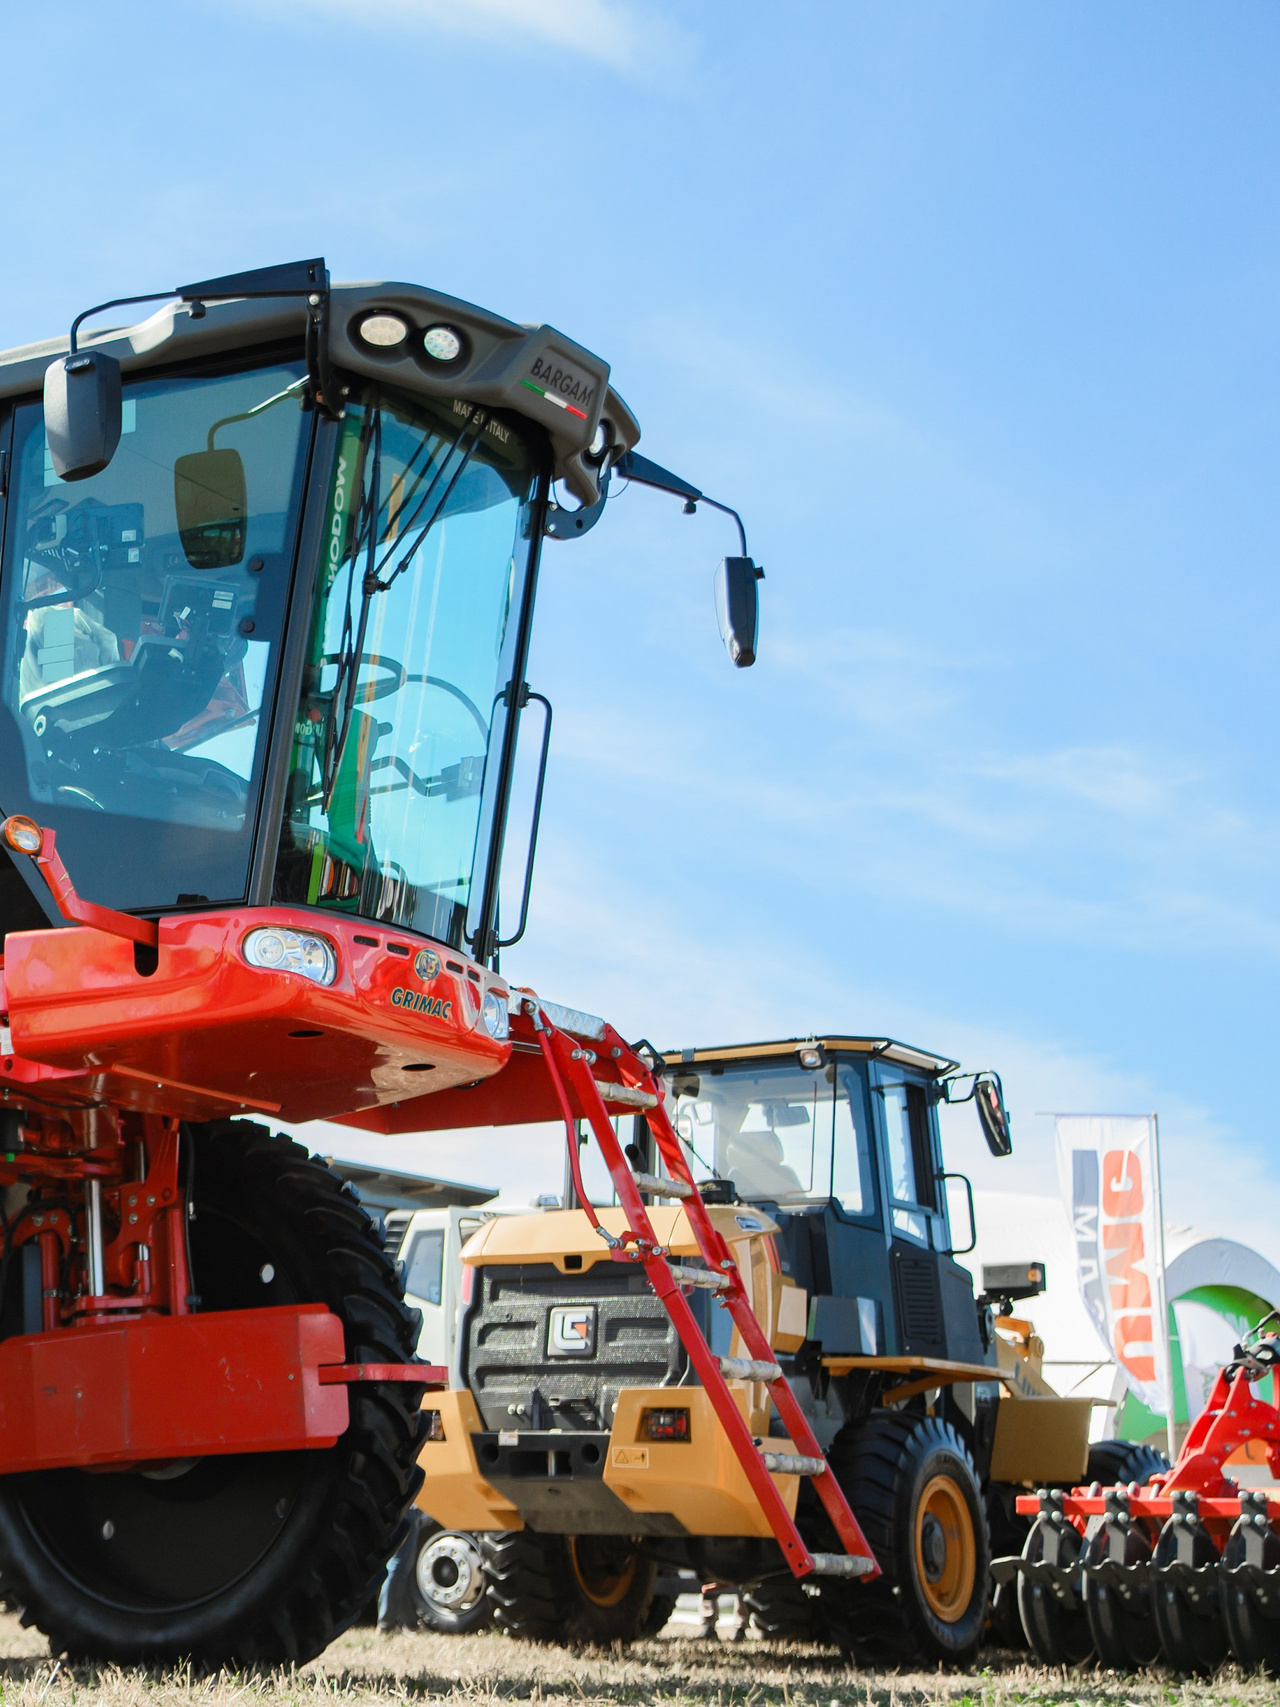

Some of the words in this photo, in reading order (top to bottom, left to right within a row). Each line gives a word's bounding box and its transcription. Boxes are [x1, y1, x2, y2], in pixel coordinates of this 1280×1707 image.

[530, 357, 594, 406] BARGAM
[489, 420, 509, 443] ITALY
[391, 986, 452, 1019] GRIMAC
